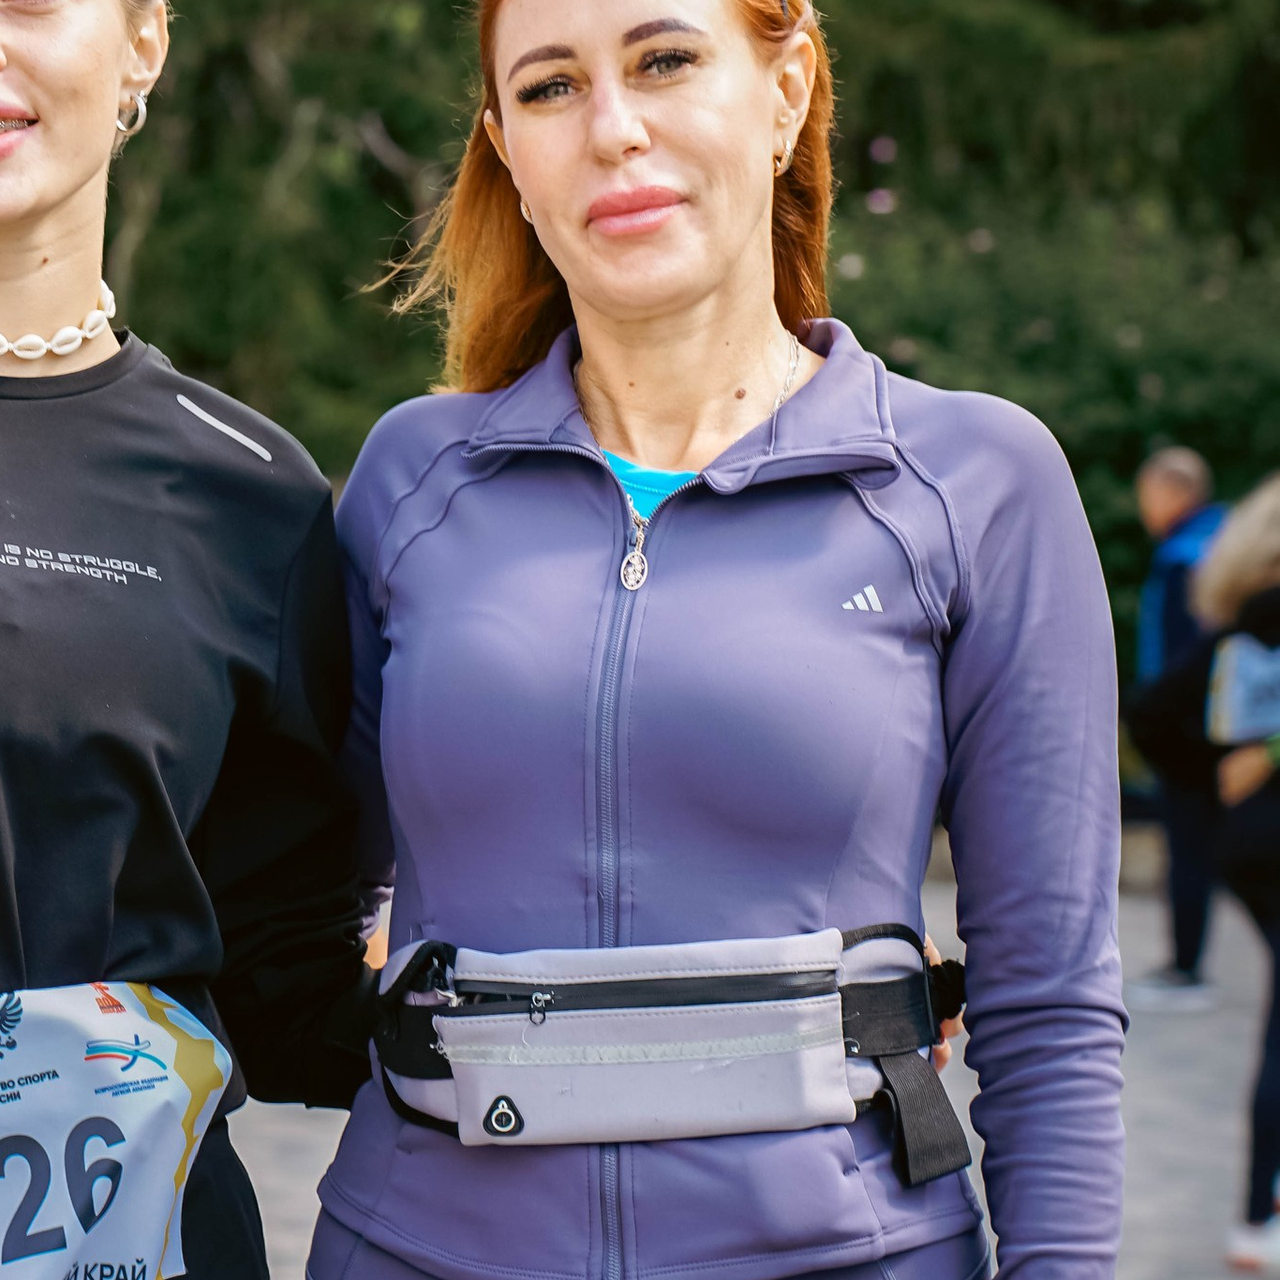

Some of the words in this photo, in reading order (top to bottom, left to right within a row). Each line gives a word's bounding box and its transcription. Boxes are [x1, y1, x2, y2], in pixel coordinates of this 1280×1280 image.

[4, 543, 21, 555] IS
[26, 547, 53, 560] NO
[58, 552, 162, 582] STRUGGLE,
[25, 558, 128, 584] STRENGTH
[17, 1069, 60, 1086] СПОРТА
